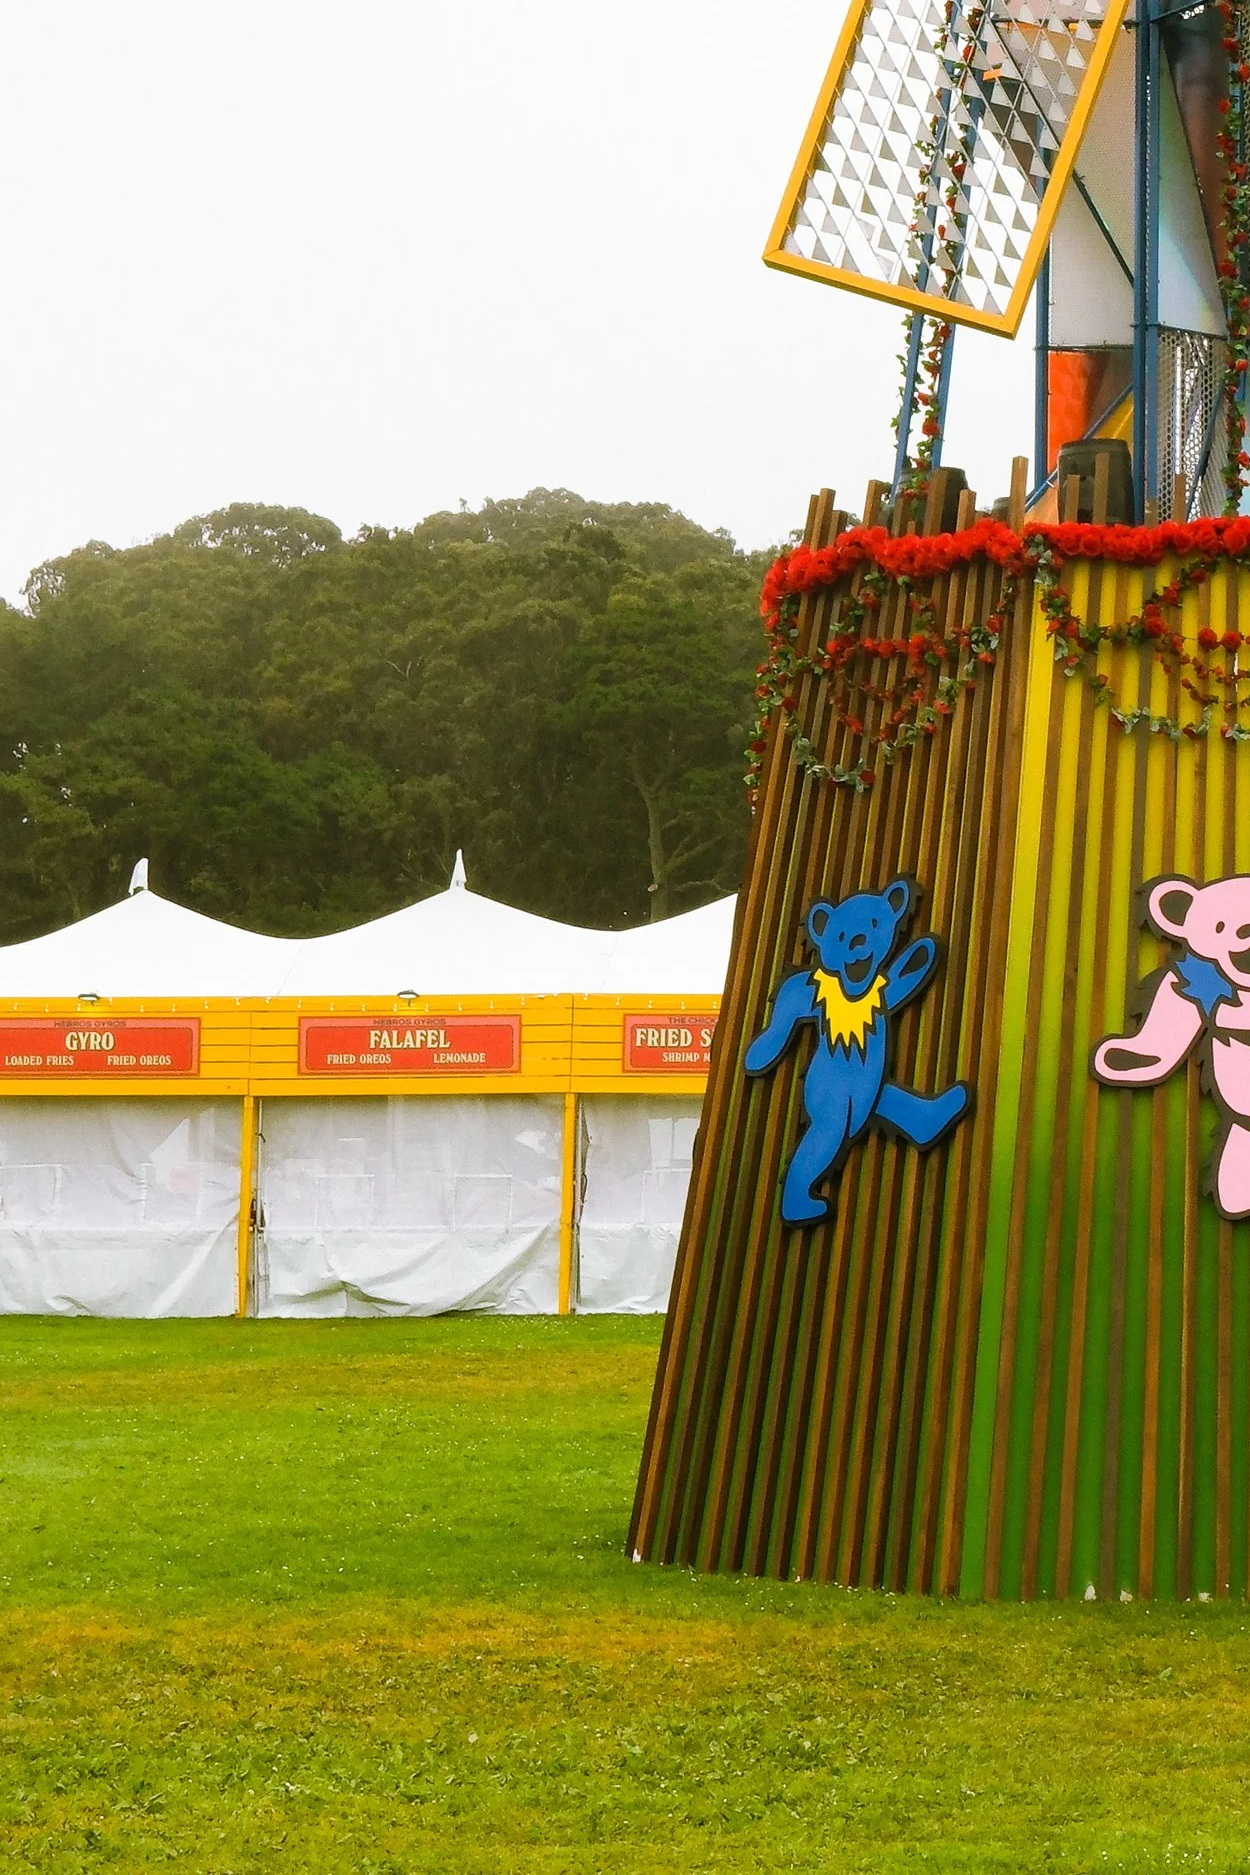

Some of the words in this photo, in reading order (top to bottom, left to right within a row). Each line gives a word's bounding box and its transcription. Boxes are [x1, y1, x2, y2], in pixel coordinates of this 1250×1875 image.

[65, 1031, 115, 1051] GYRO
[369, 1029, 450, 1049] FALAFEL
[635, 1028, 692, 1047] FRIED
[5, 1055, 43, 1066] LOADED
[46, 1055, 75, 1066] FRIES
[107, 1055, 137, 1065] FRIED
[139, 1055, 172, 1065] OREOS
[327, 1053, 356, 1065] FRIED
[359, 1053, 392, 1064] OREOS
[433, 1052, 486, 1064] LEMONADE
[662, 1052, 700, 1063] SHRIMP
